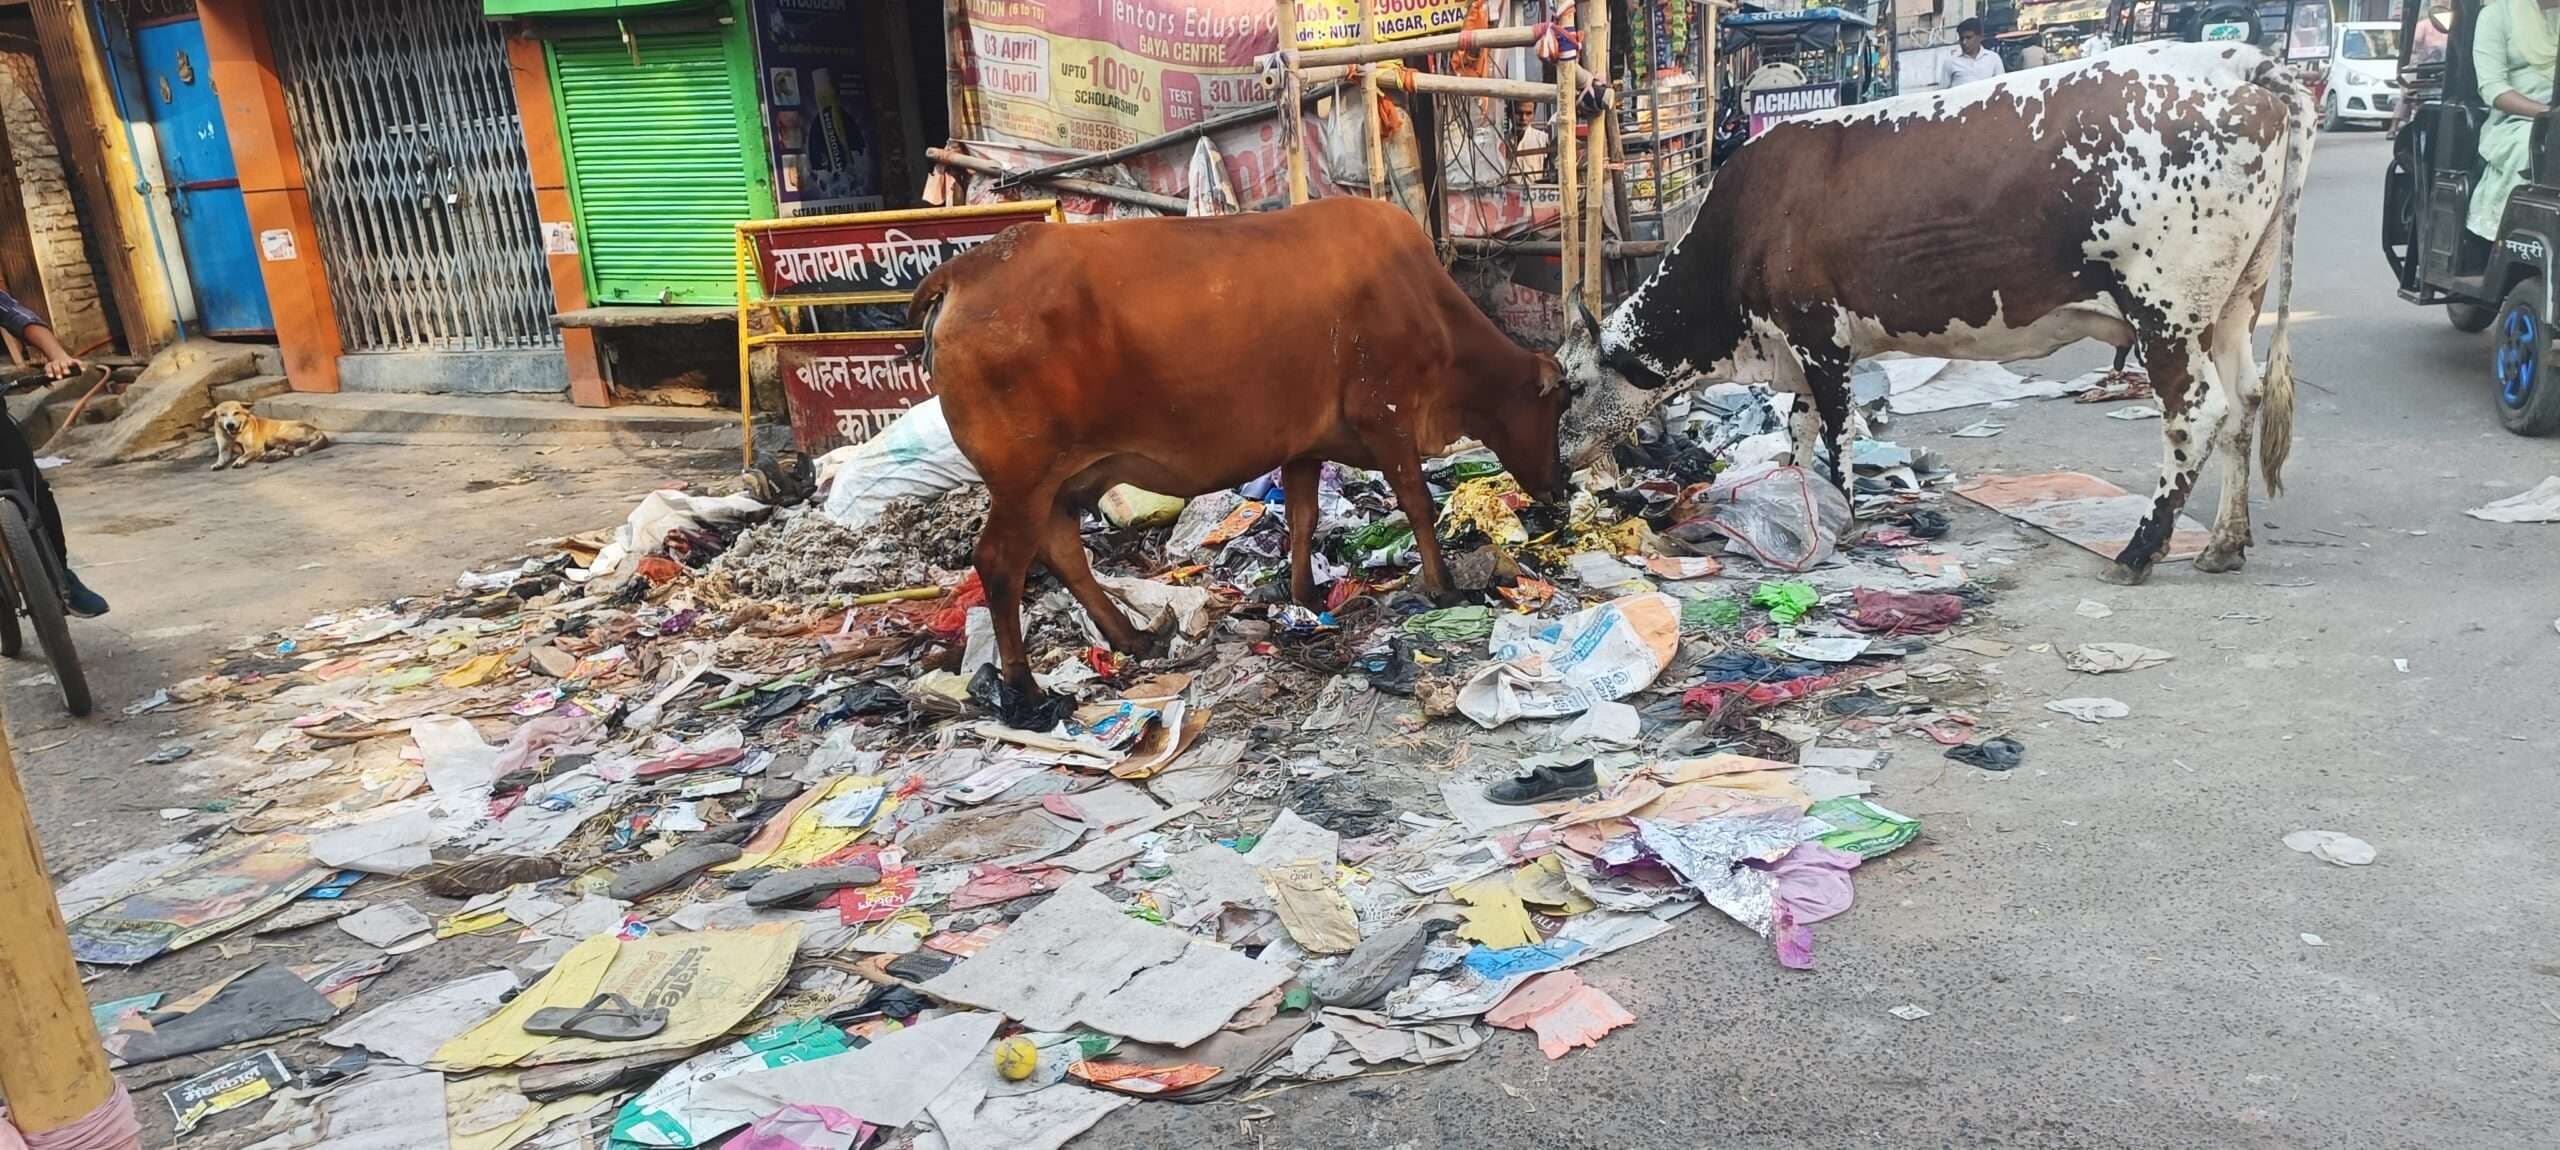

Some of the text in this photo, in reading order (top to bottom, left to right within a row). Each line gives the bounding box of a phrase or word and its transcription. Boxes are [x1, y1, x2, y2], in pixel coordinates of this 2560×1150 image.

[1377, 15, 1428, 36] NAGAR,
[1431, 9, 1465, 27] GAYA
[1002, 37, 1038, 61] April
[1139, 34, 1227, 63] GAYA CENTRE
[984, 65, 1038, 93] 10 April
[1061, 55, 1151, 103] UPTO 100%
[1210, 79, 1231, 103] 30
[1074, 89, 1139, 117] SCHOLARSHIP
[1169, 88, 1193, 104] TEST
[1753, 88, 1837, 115] ACHANAK
[1170, 105, 1196, 122] DATE
[792, 205, 823, 218] SITARA
[771, 243, 868, 285] यातायात
[867, 228, 943, 287] पुलिस
[2505, 240, 2544, 260] मयूरी
[796, 355, 851, 398] वाहन
[848, 343, 918, 392] चलाते
[833, 408, 871, 445] का
